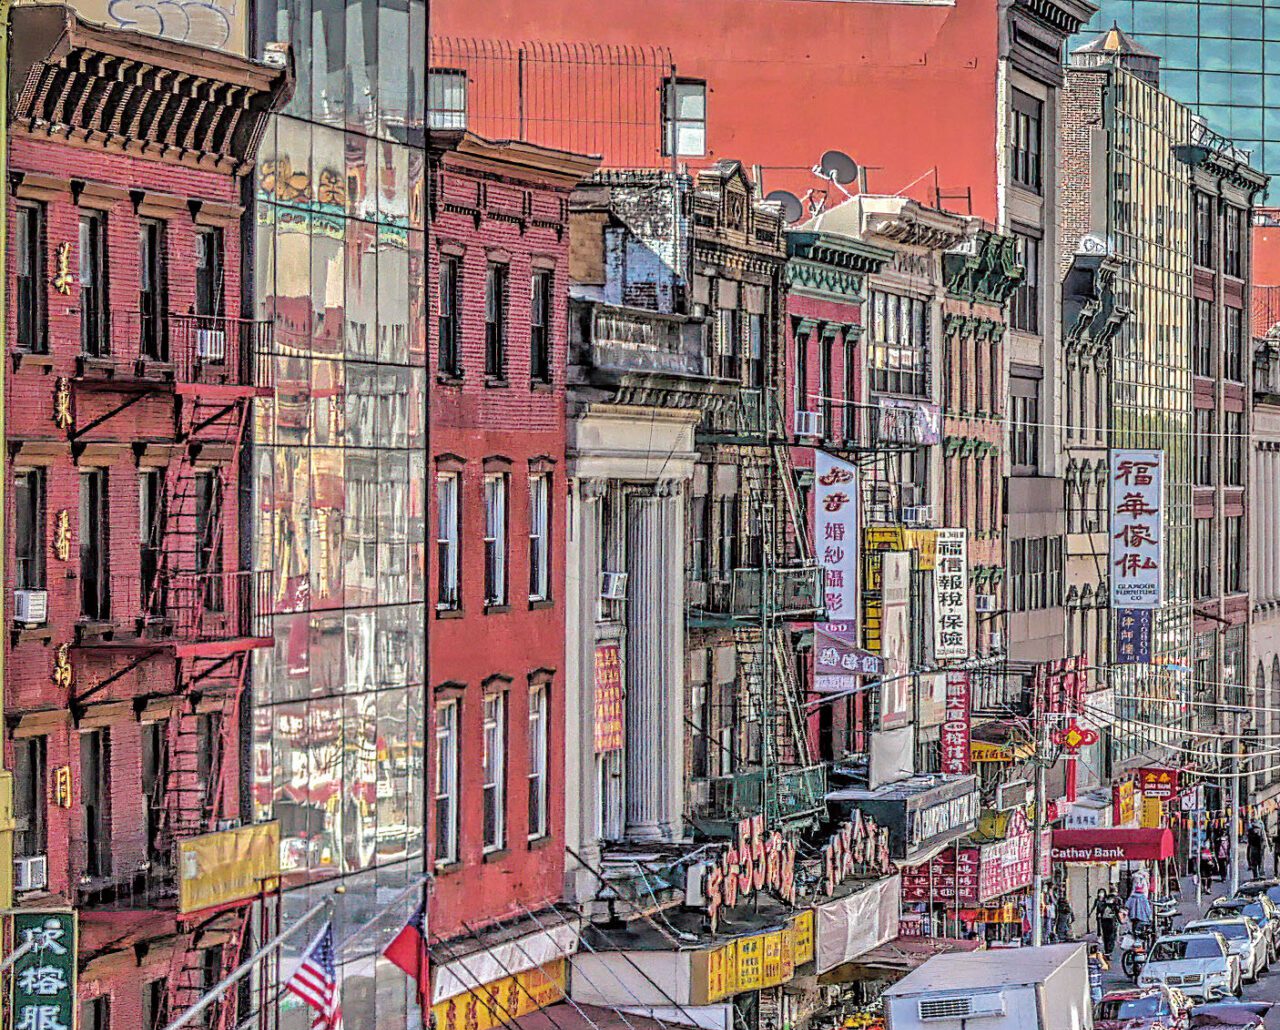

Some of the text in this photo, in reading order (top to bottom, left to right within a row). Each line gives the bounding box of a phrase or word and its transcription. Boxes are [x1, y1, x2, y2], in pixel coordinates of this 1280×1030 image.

[1114, 460, 1159, 578] 福華傢俬
[1051, 847, 1124, 860] Cathay Bank
